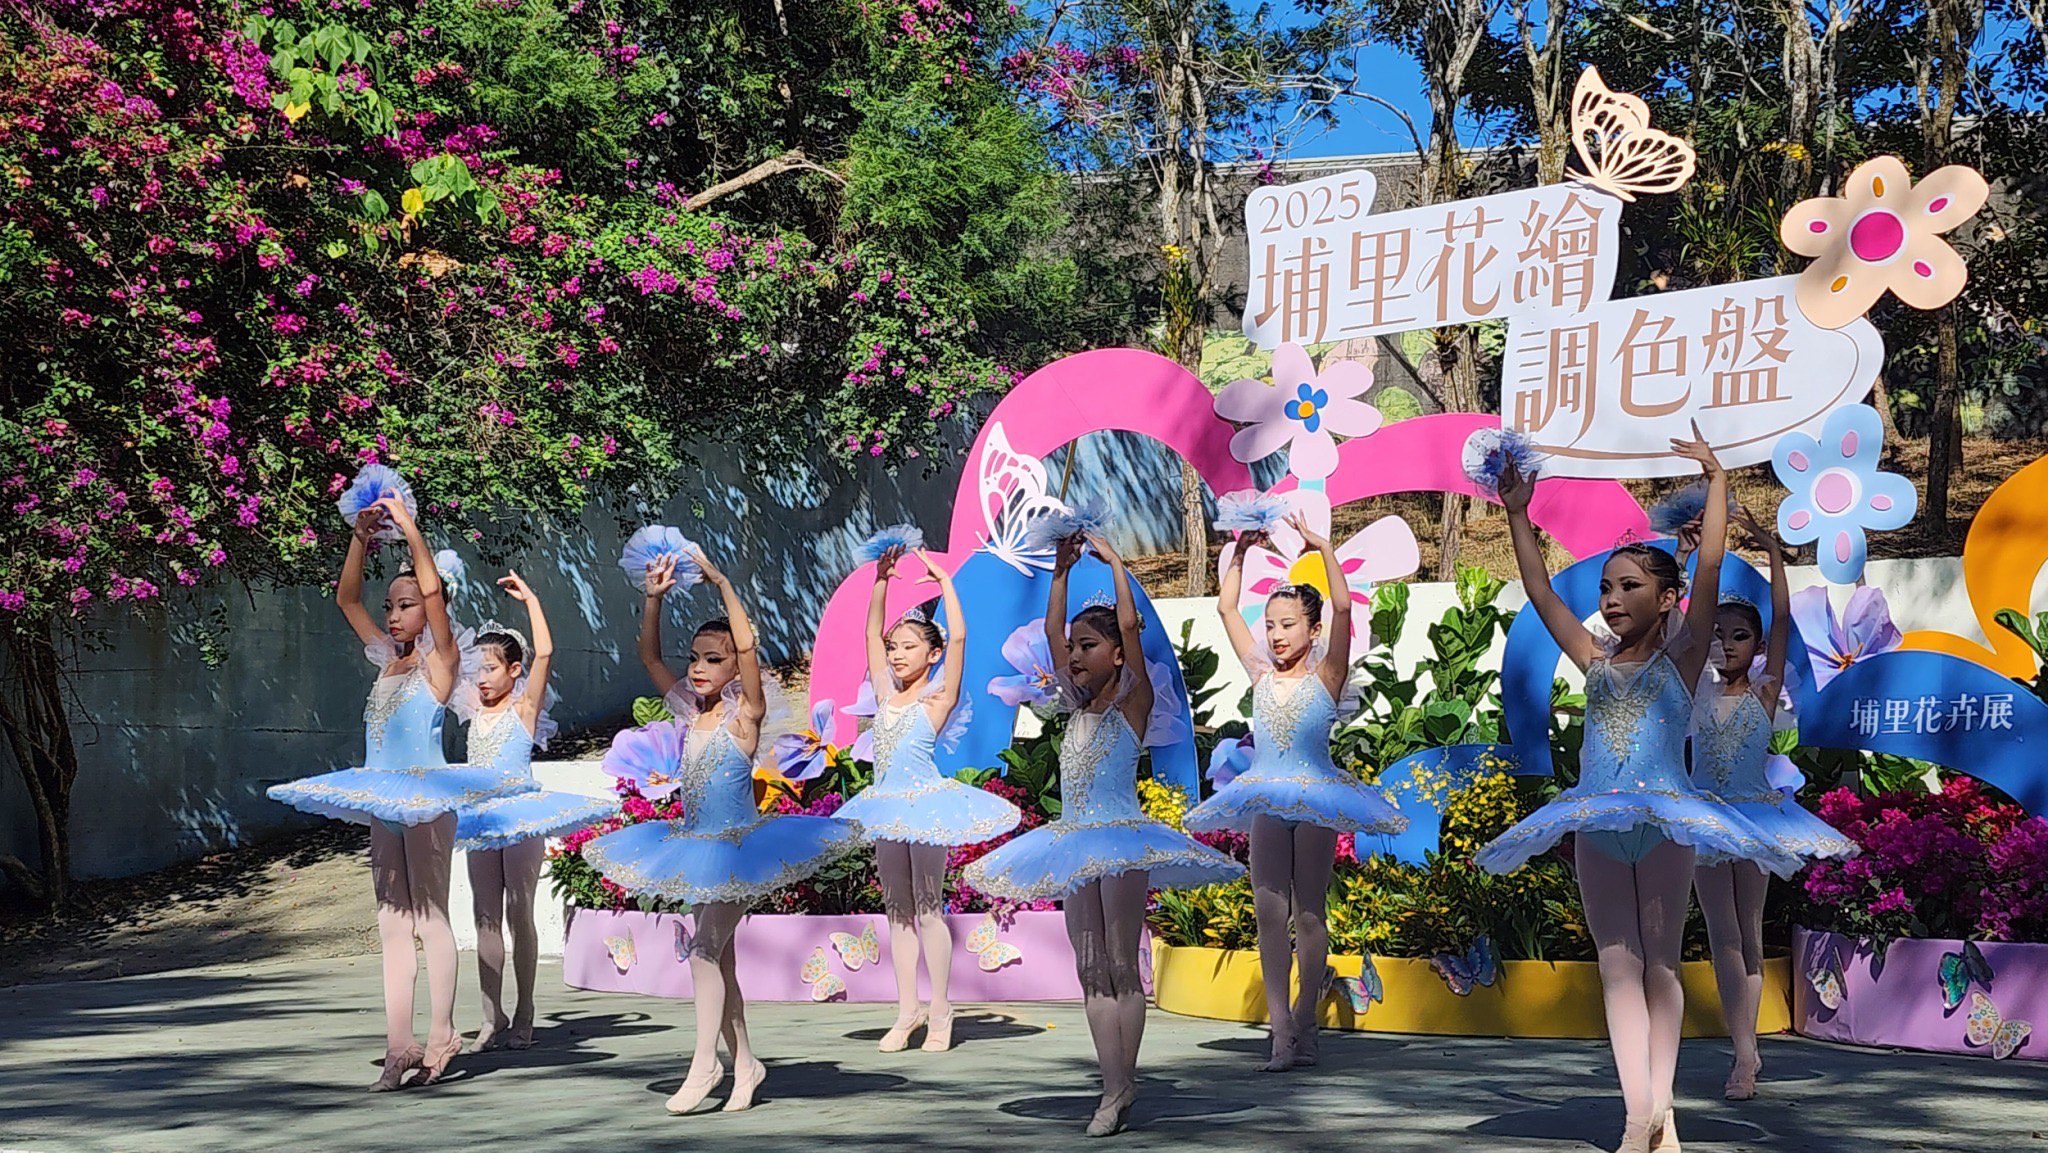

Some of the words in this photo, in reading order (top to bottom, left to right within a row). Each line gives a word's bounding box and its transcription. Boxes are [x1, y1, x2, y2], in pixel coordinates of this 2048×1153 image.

[1258, 181, 1361, 235] 2025
[1255, 193, 1604, 344] 埔里花繪
[1514, 295, 1793, 446] 調色盤
[1850, 693, 2014, 739] 埔里花卉展
